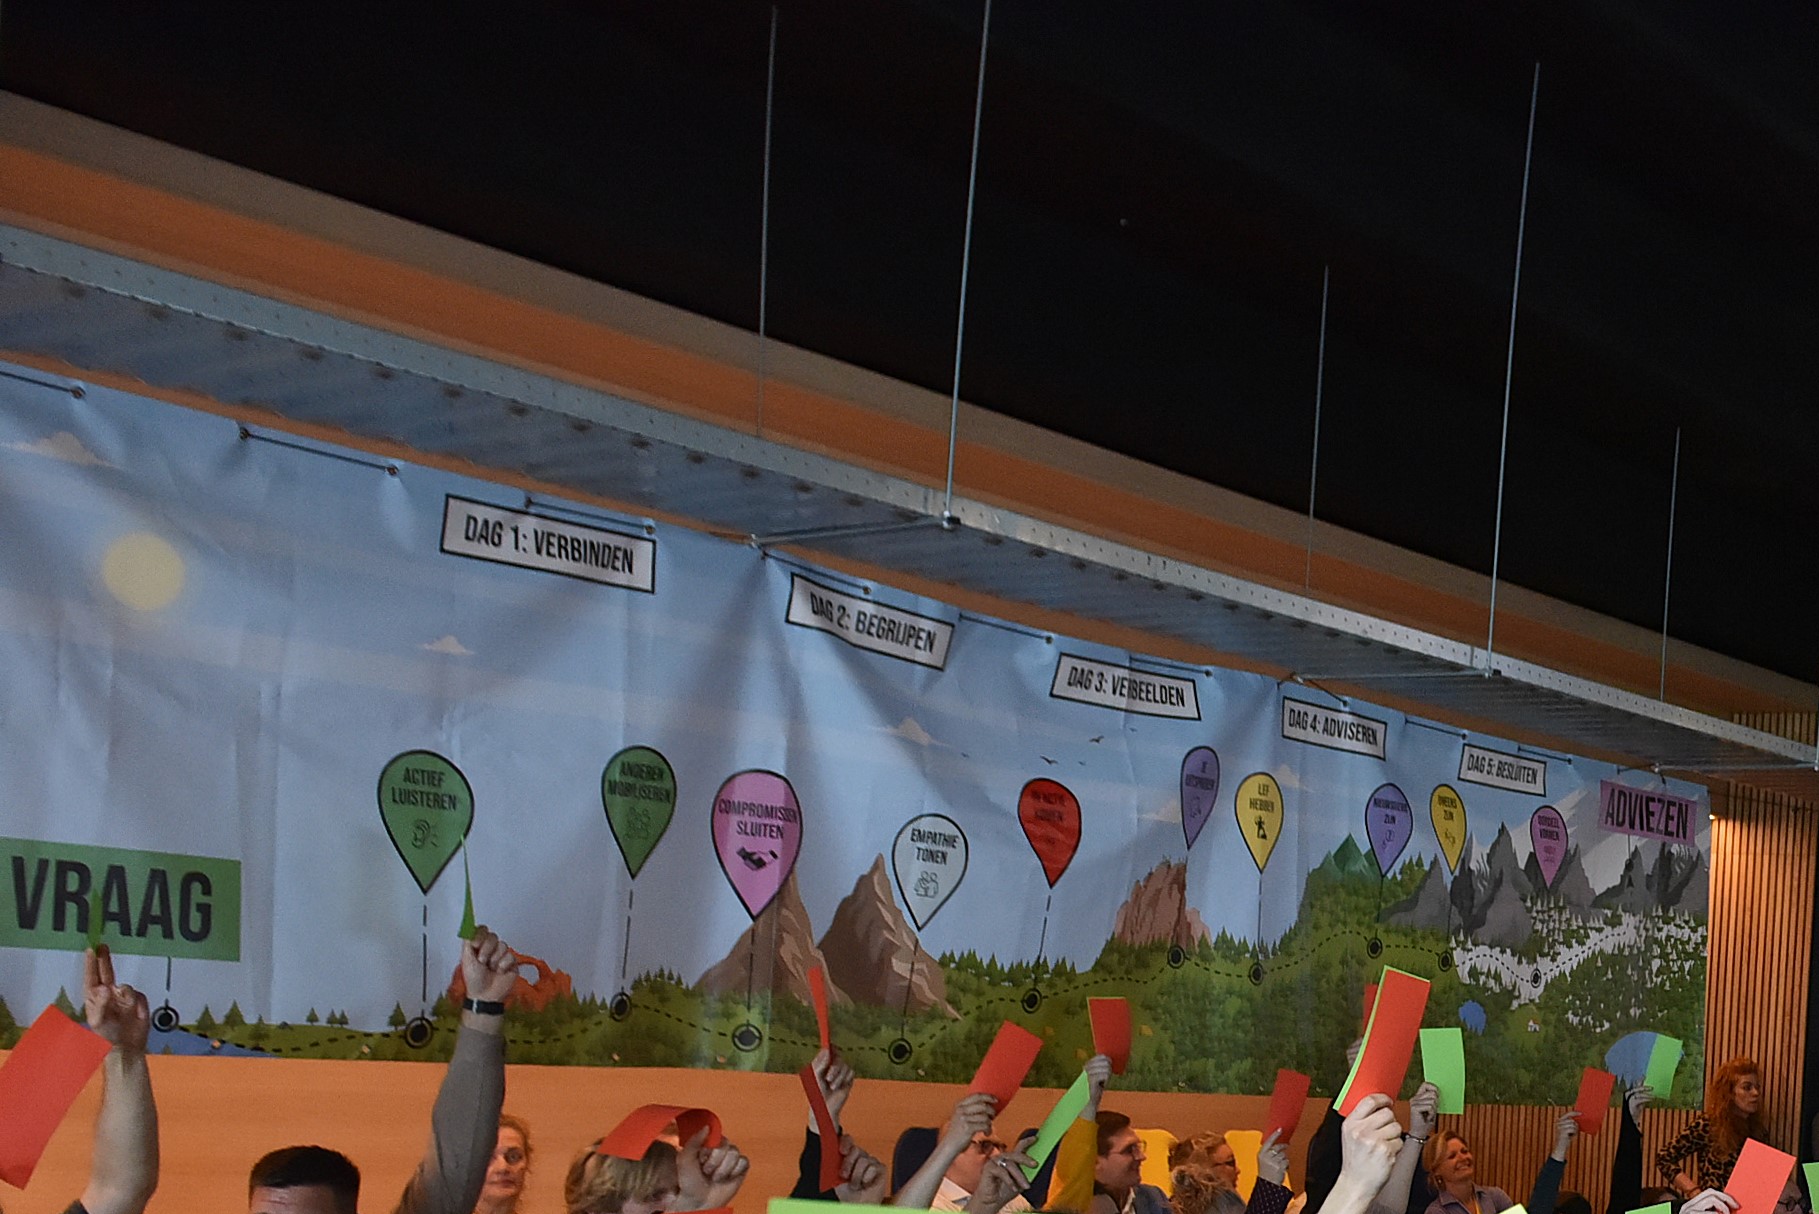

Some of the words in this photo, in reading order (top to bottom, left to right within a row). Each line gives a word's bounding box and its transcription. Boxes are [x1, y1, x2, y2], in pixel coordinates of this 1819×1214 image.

[464, 513, 503, 547] DAG
[510, 524, 528, 554] 1:
[533, 528, 635, 575] VERBINDEN
[810, 591, 834, 623] DAG
[837, 604, 850, 630] 2:
[855, 610, 938, 653] BEGRIJPEN
[1067, 666, 1094, 690] DAG
[1094, 672, 1108, 694] 3:
[1289, 708, 1309, 730] DAG
[1310, 714, 1321, 734] 4:
[1322, 717, 1378, 746] ADVISEREN
[403, 767, 446, 787] ACTIEF
[1467, 752, 1487, 774] DAG
[1486, 758, 1496, 776] 5:
[1496, 760, 1539, 785] BESLUITEN
[391, 786, 457, 811] LUISTEREN
[1257, 783, 1270, 797] LEF
[1249, 797, 1275, 813] HEBBEN
[1605, 787, 1689, 840] ADVIEZEN
[736, 820, 784, 839] SLUITEN
[910, 828, 960, 849] EMPATHIE
[916, 846, 948, 865] TONEN
[11, 855, 213, 942] VRAAG
